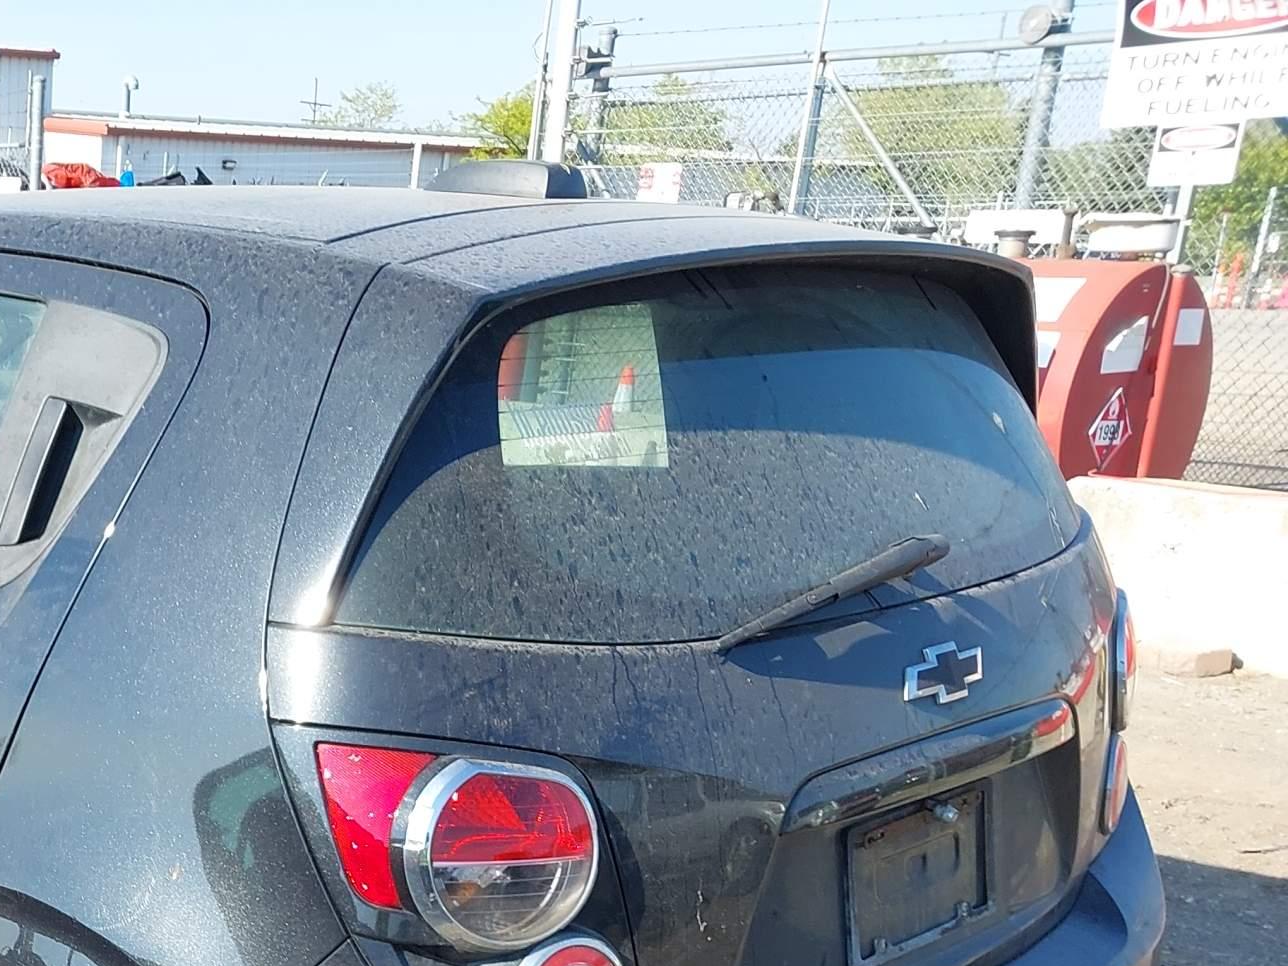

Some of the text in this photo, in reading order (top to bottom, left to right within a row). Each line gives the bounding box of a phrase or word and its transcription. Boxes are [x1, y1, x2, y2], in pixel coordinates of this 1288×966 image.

[1155, 0, 1288, 29] DANGE
[1127, 50, 1201, 71] TURN
[1137, 75, 1185, 93] OFF
[1147, 94, 1270, 115] FUELING
